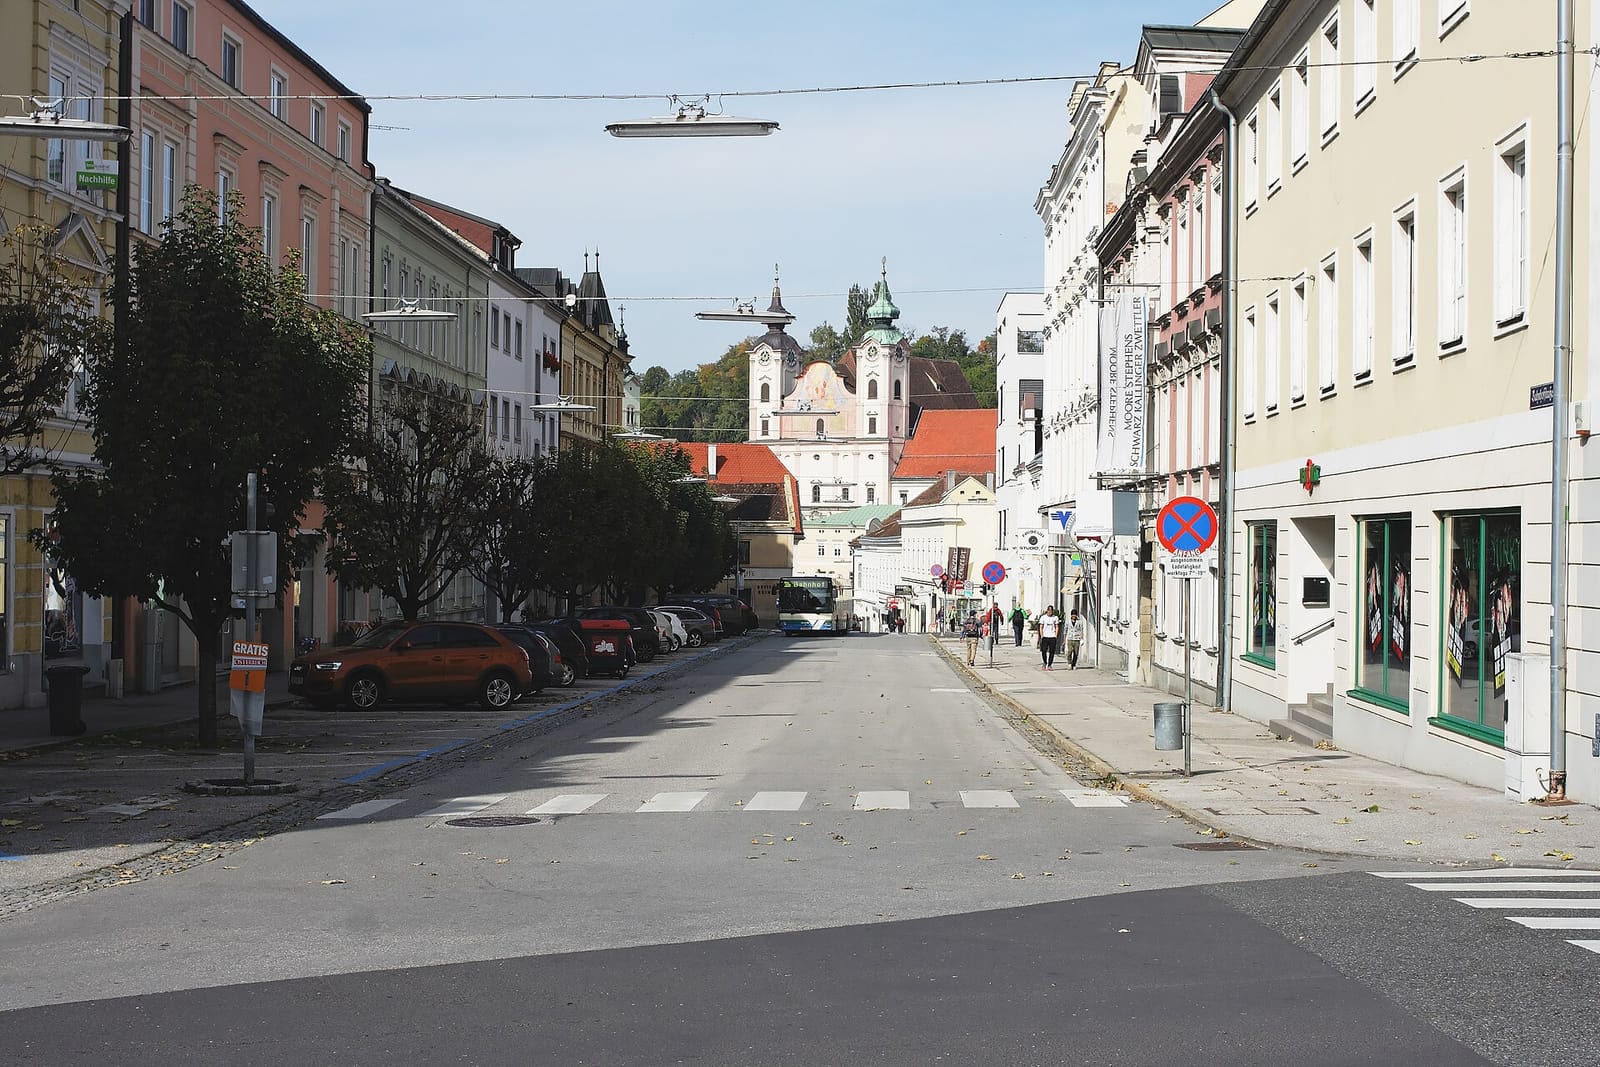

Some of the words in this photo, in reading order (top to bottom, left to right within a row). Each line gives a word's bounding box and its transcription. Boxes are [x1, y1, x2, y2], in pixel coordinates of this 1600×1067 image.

[79, 174, 116, 185] Nachhilfe
[1132, 297, 1143, 351] ZWETTLER
[1124, 333, 1134, 388] STEPHENS
[1134, 354, 1143, 413] KALLINGER
[1124, 391, 1134, 431] MOORE
[1130, 416, 1142, 467] SCHWARZ
[1173, 548, 1201, 557] ANFANG
[233, 642, 269, 657] GRATIS
